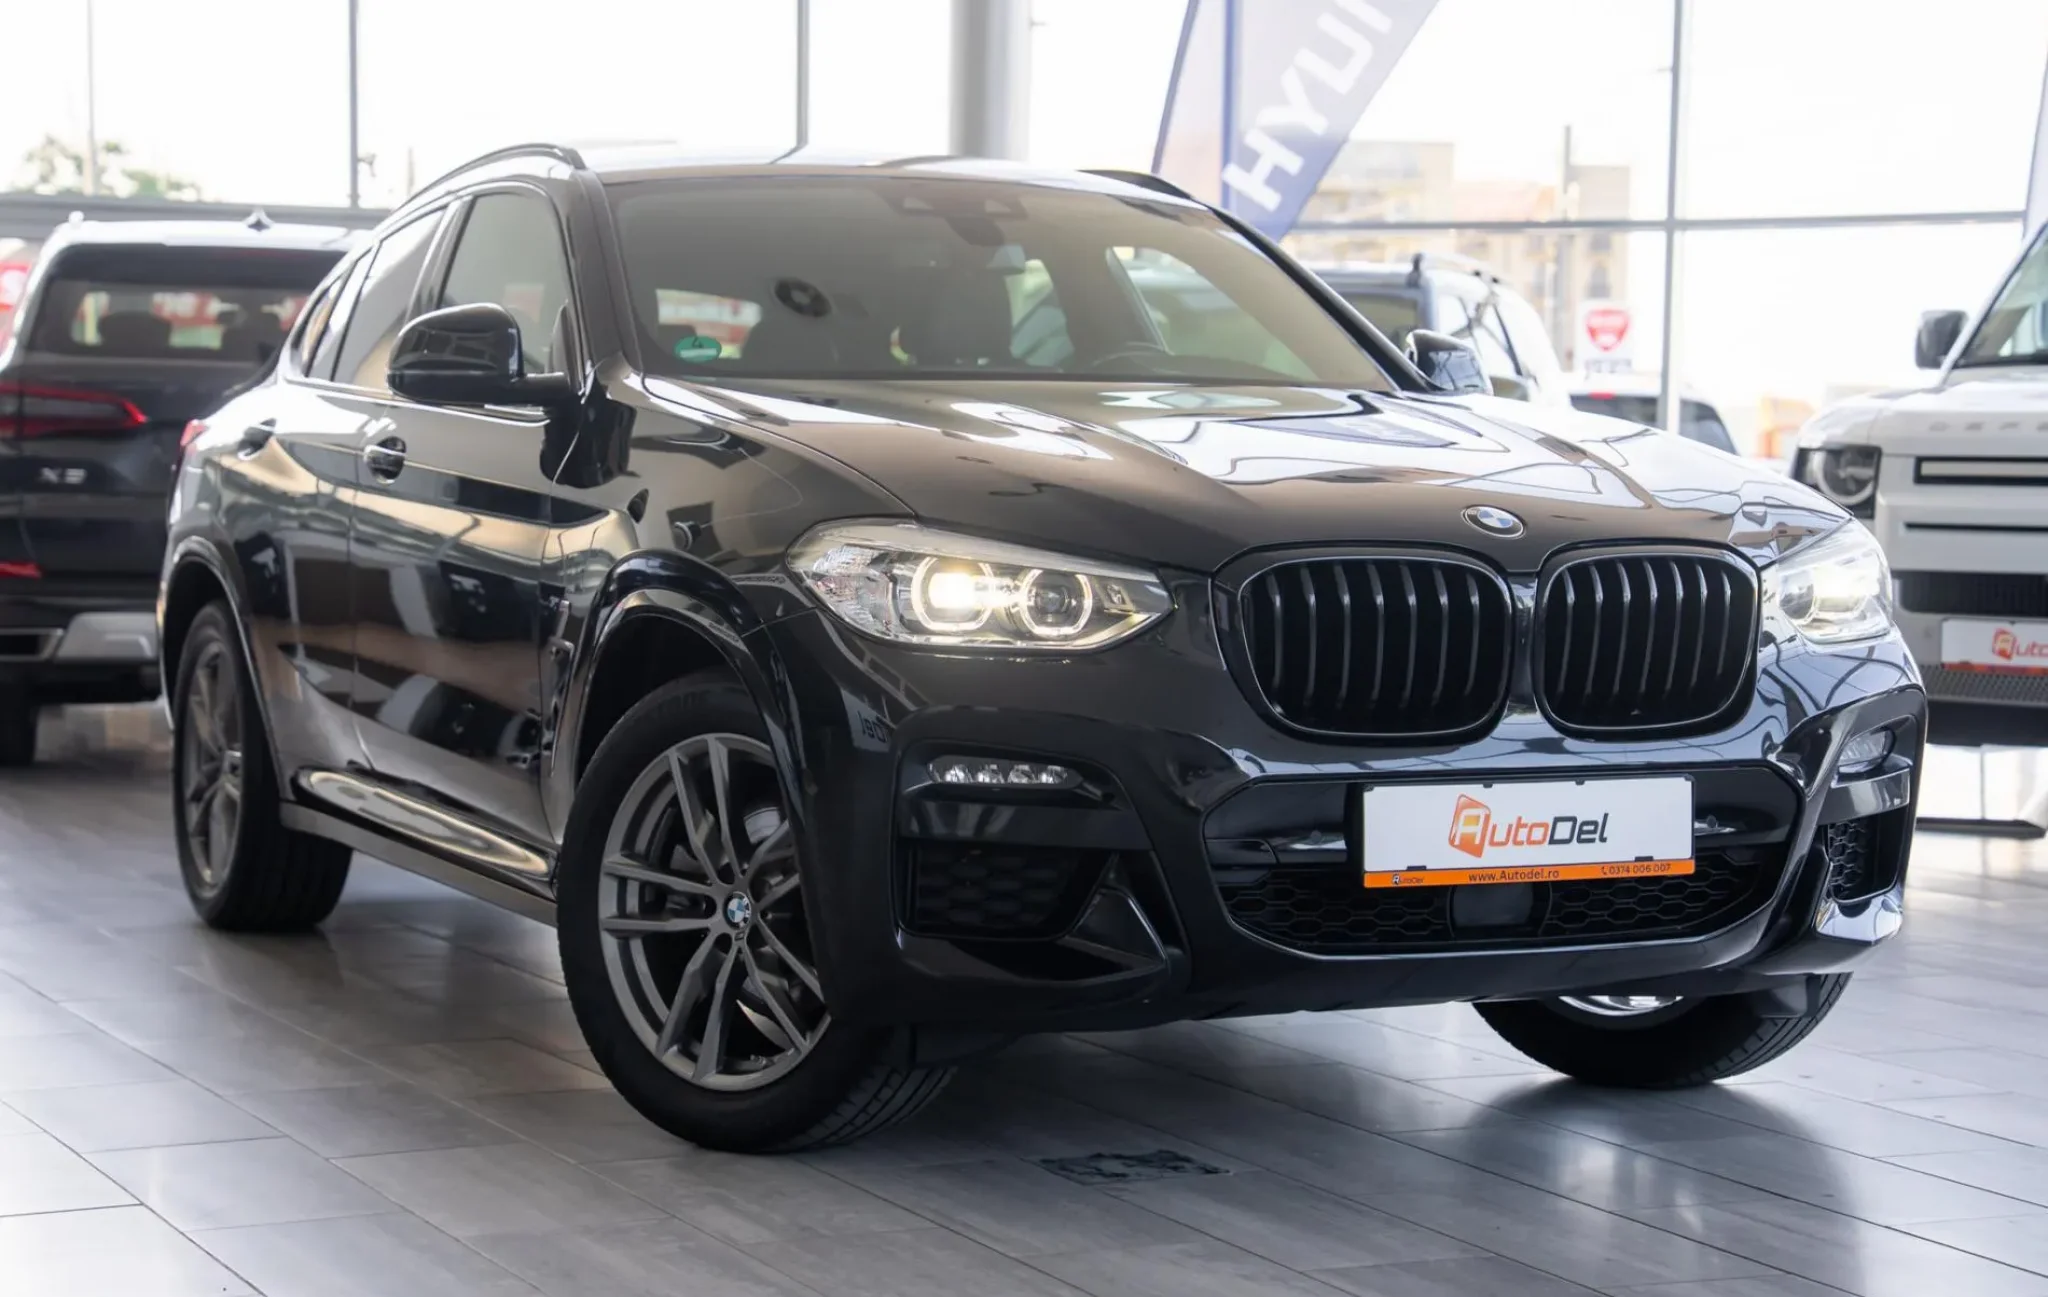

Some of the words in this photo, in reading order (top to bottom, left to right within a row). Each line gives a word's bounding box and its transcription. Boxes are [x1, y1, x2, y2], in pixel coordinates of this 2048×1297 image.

[1221, 0, 1393, 213] HYU
[1451, 803, 1609, 850] AutoDel
[1468, 868, 1560, 882] www.Autodel.ro
[1608, 864, 1631, 875] 0374
